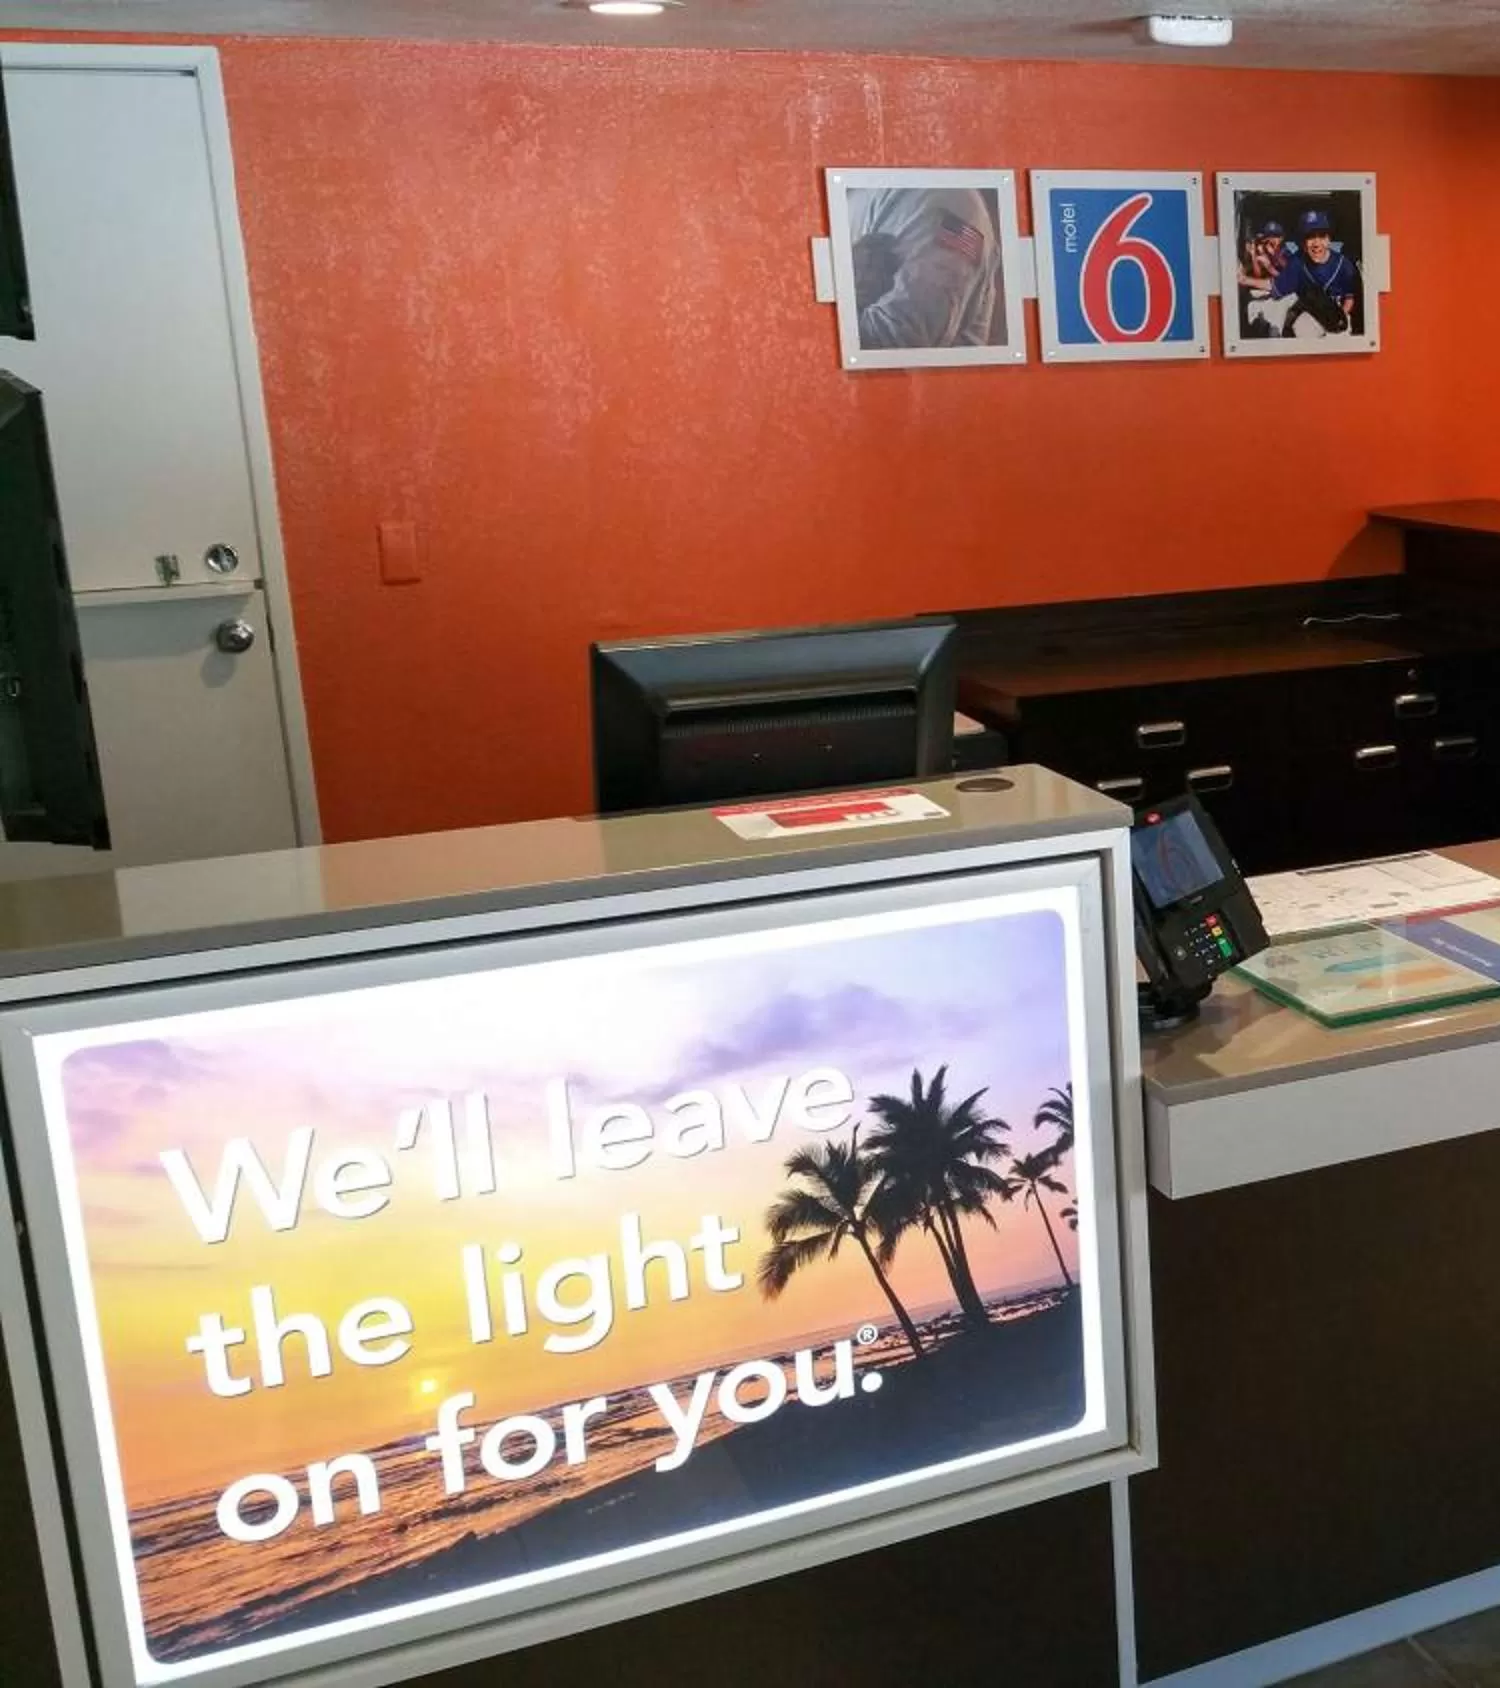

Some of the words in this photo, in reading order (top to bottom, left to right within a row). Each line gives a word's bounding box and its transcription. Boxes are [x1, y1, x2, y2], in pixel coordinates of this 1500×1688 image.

[1060, 202, 1077, 253] motel
[1079, 192, 1176, 345] 6
[159, 1090, 499, 1246] We'll
[547, 1065, 857, 1182] leave
[187, 1285, 415, 1399] the
[463, 1212, 745, 1355] light
[214, 1450, 381, 1543] on
[426, 1391, 608, 1497] for
